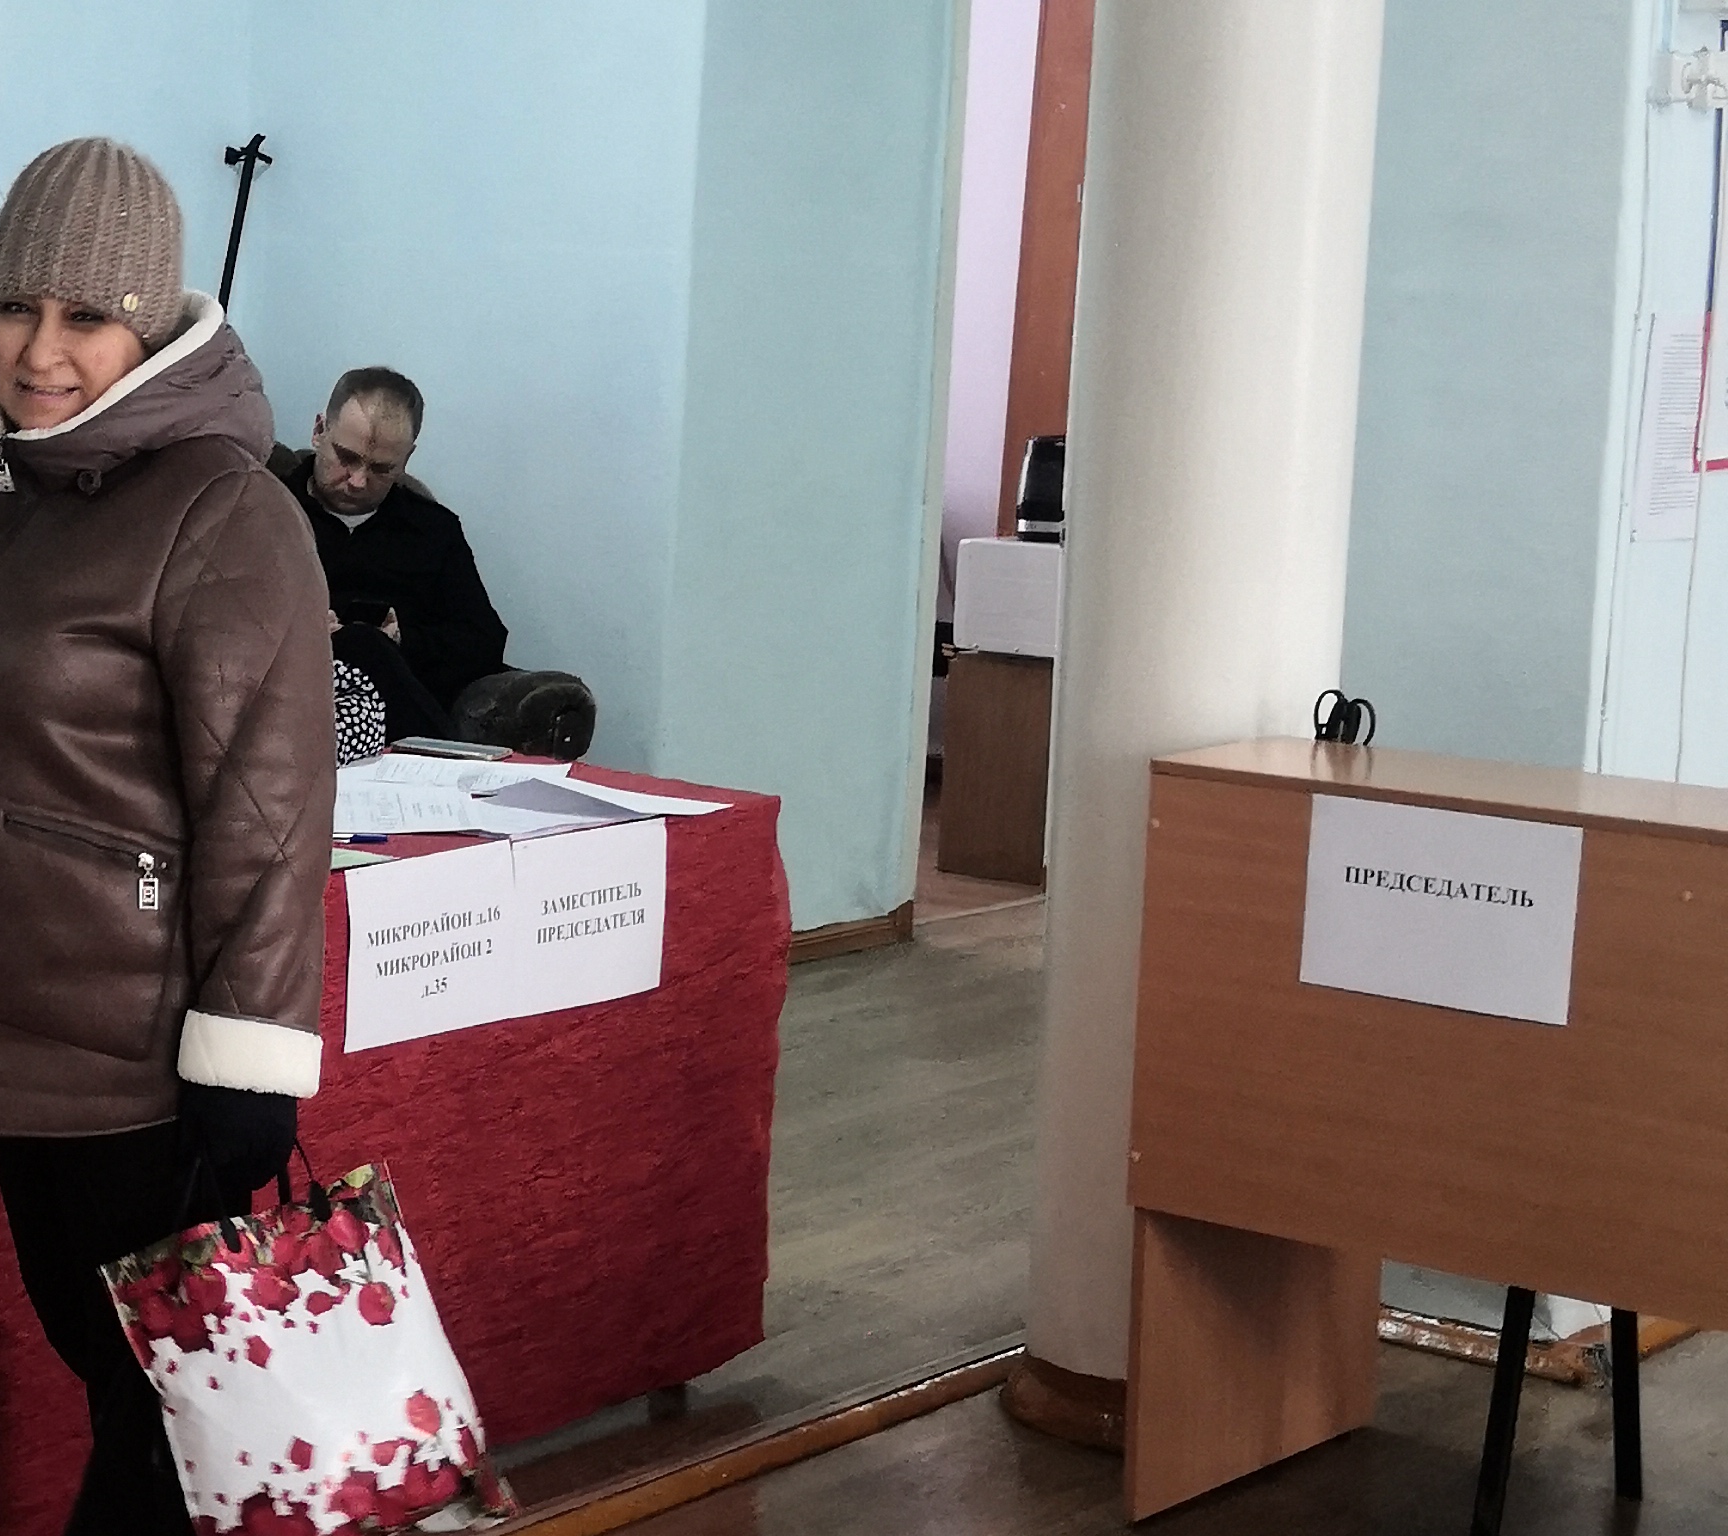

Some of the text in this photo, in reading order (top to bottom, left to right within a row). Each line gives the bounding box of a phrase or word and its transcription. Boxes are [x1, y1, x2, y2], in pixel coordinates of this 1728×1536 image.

[540, 881, 642, 916] ЗАМЕСТИТЕЛЬ
[1343, 864, 1535, 910] ПРЕДСЕДАТЕЛЬ
[366, 911, 473, 949] МИКРОРАЙОН
[536, 907, 646, 945] ПРЕДСЕДАТЕЛЯ
[375, 938, 493, 979] МИКРОРАЙОН 2
